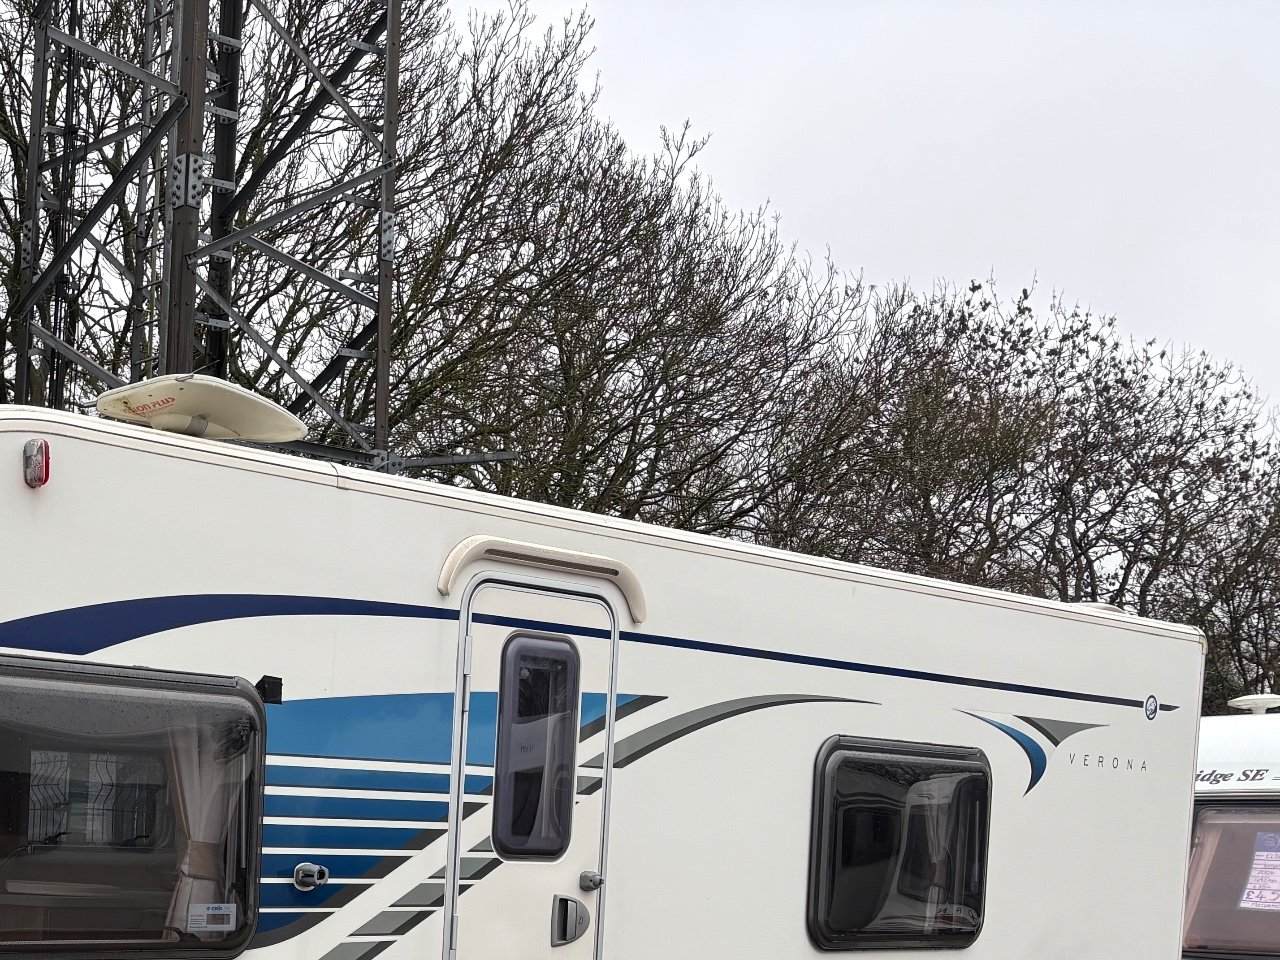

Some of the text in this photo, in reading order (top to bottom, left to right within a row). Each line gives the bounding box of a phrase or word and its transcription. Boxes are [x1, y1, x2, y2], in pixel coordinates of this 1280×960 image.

[1069, 753, 1147, 772] VERONA
[1195, 768, 1270, 785] idge SE
